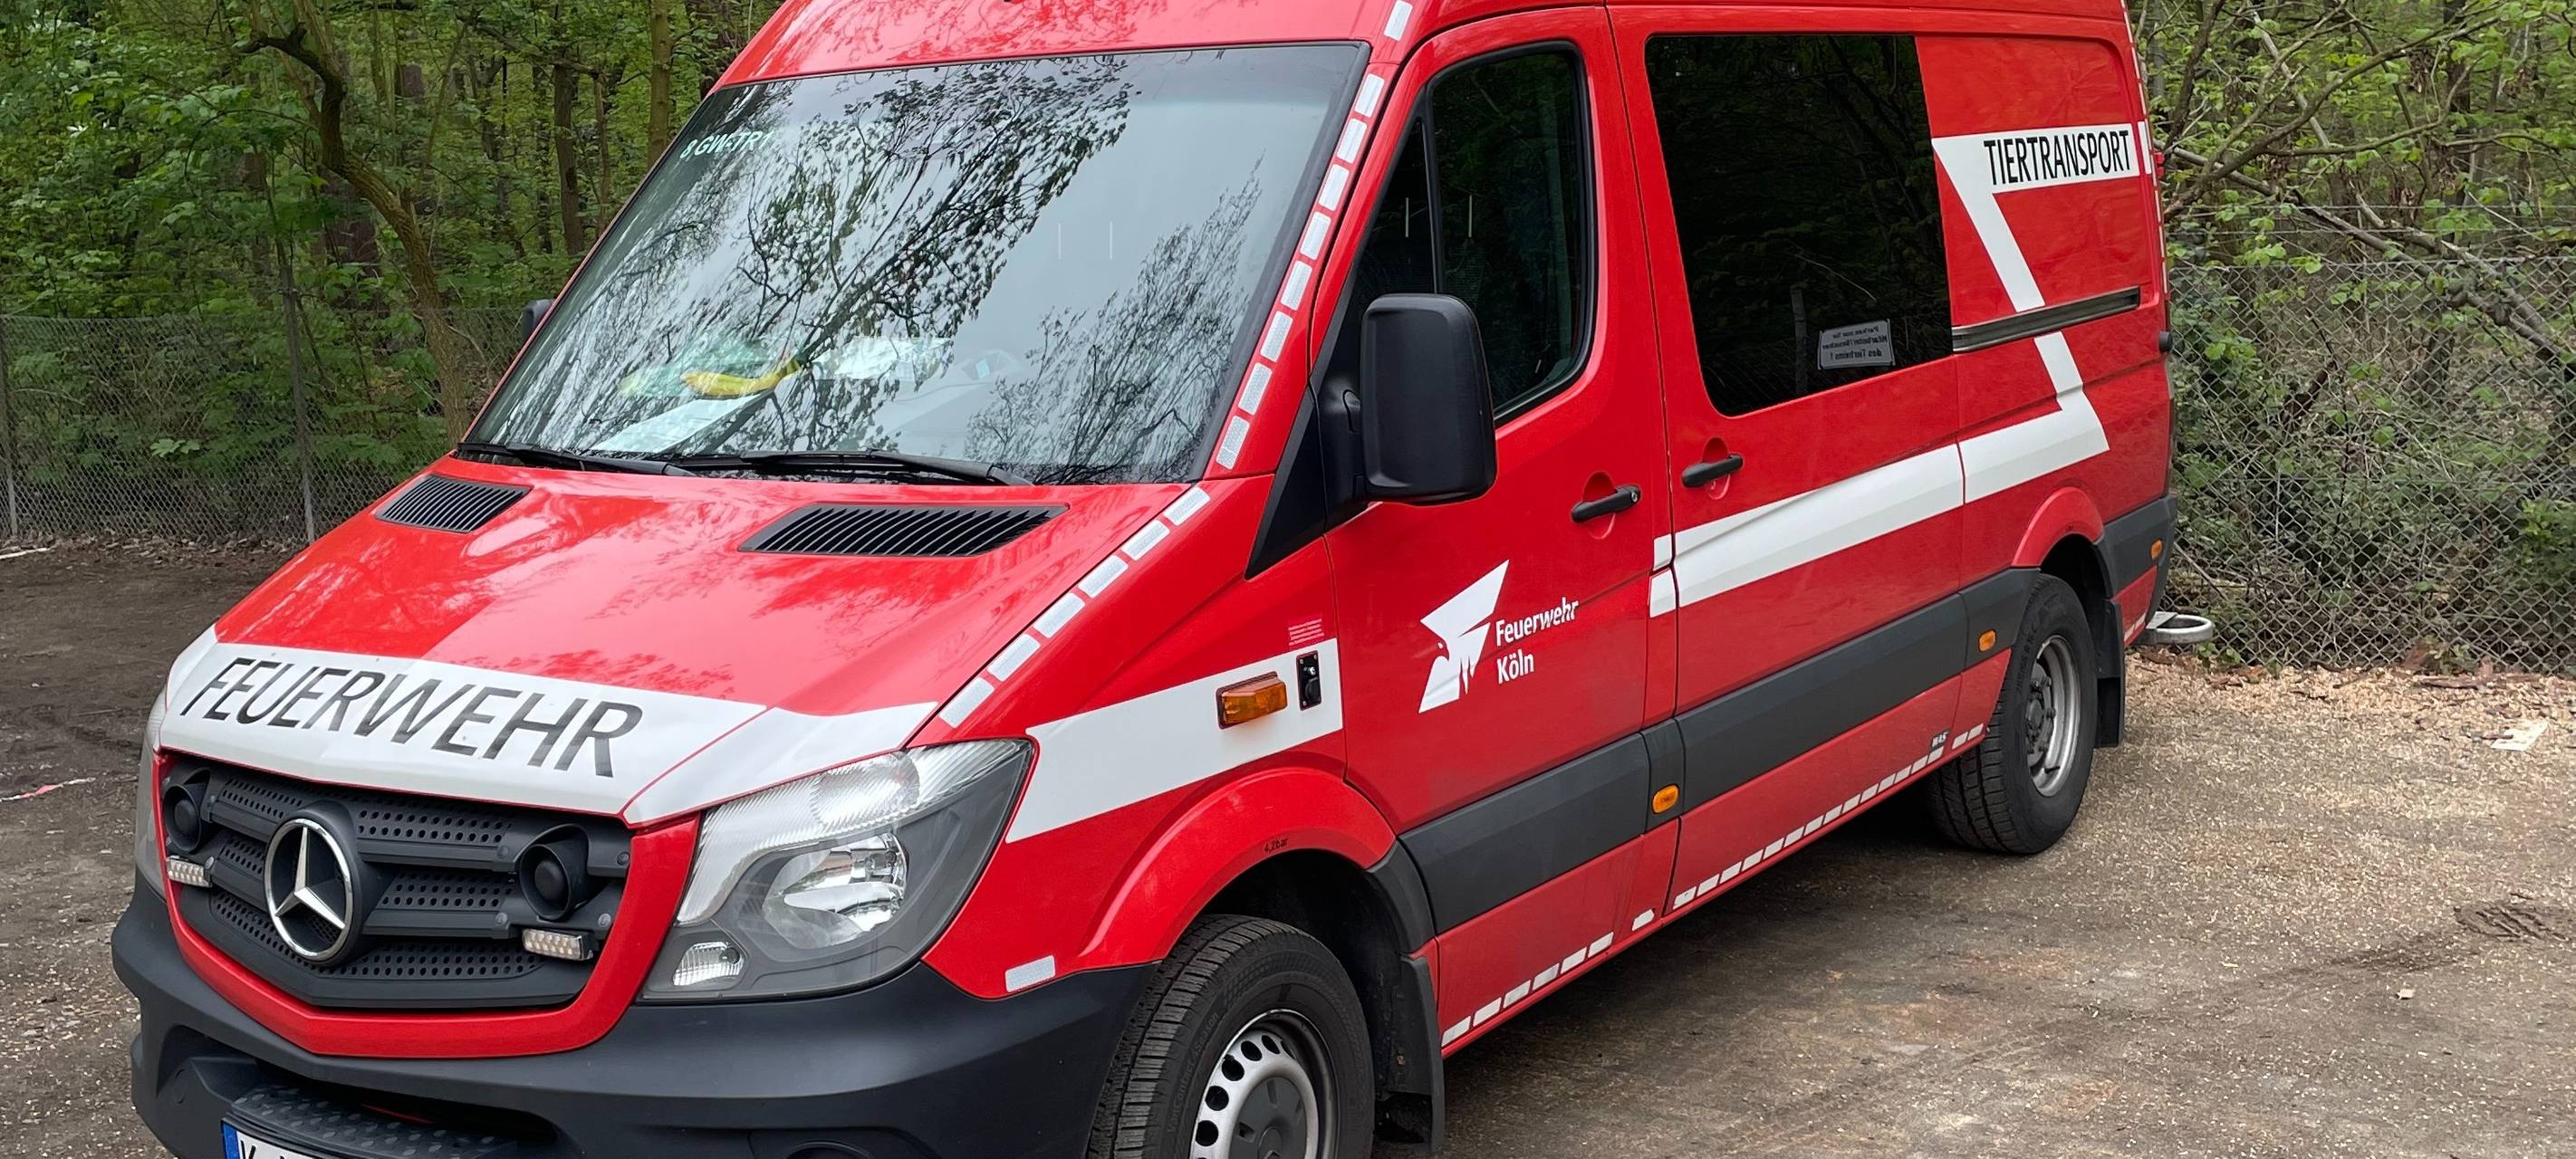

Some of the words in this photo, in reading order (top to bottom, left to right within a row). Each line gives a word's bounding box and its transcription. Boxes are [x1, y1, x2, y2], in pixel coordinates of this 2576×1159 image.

[1984, 129, 2130, 186] TIERTRANSPORT
[1495, 597, 1579, 647] Feuerwehr
[1496, 648, 1534, 685] Köln
[180, 657, 643, 779] FEUERWEHR
